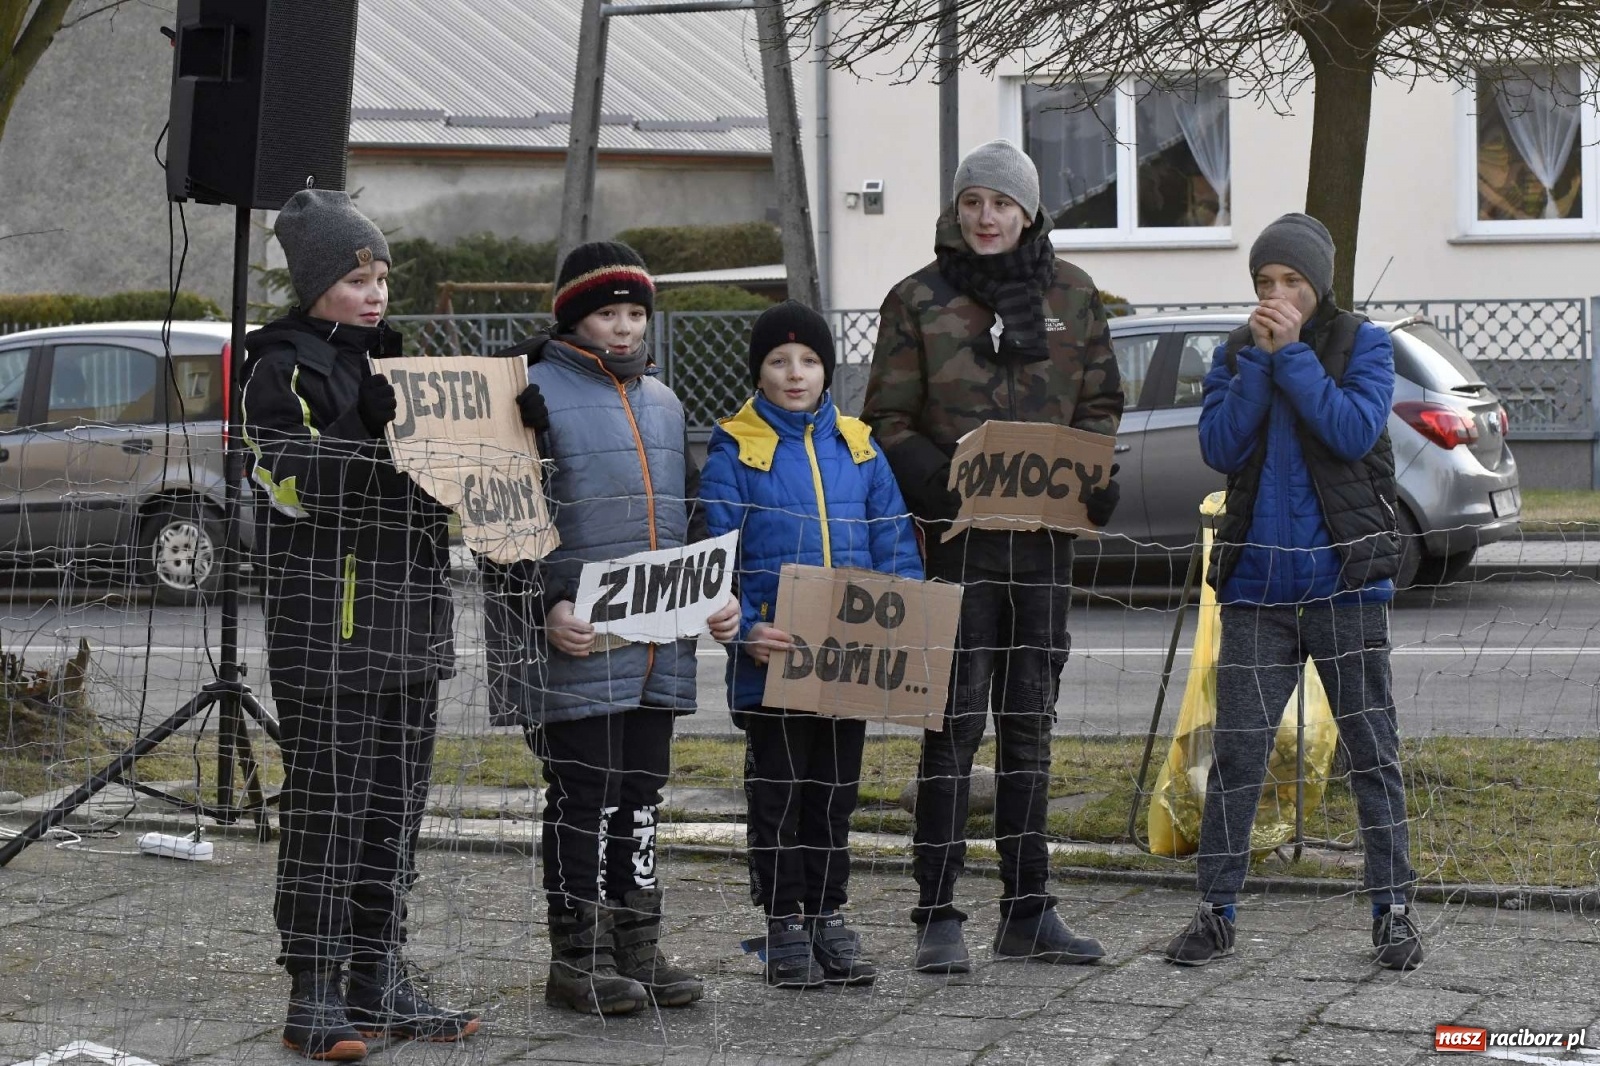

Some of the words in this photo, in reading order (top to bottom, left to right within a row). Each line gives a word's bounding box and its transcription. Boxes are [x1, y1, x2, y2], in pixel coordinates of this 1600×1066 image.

[390, 369, 491, 439] JESTEM
[955, 450, 1103, 504] POMOCY
[589, 547, 727, 624] ZIMNO
[836, 582, 905, 629] DO
[782, 634, 928, 694] DOMU...
